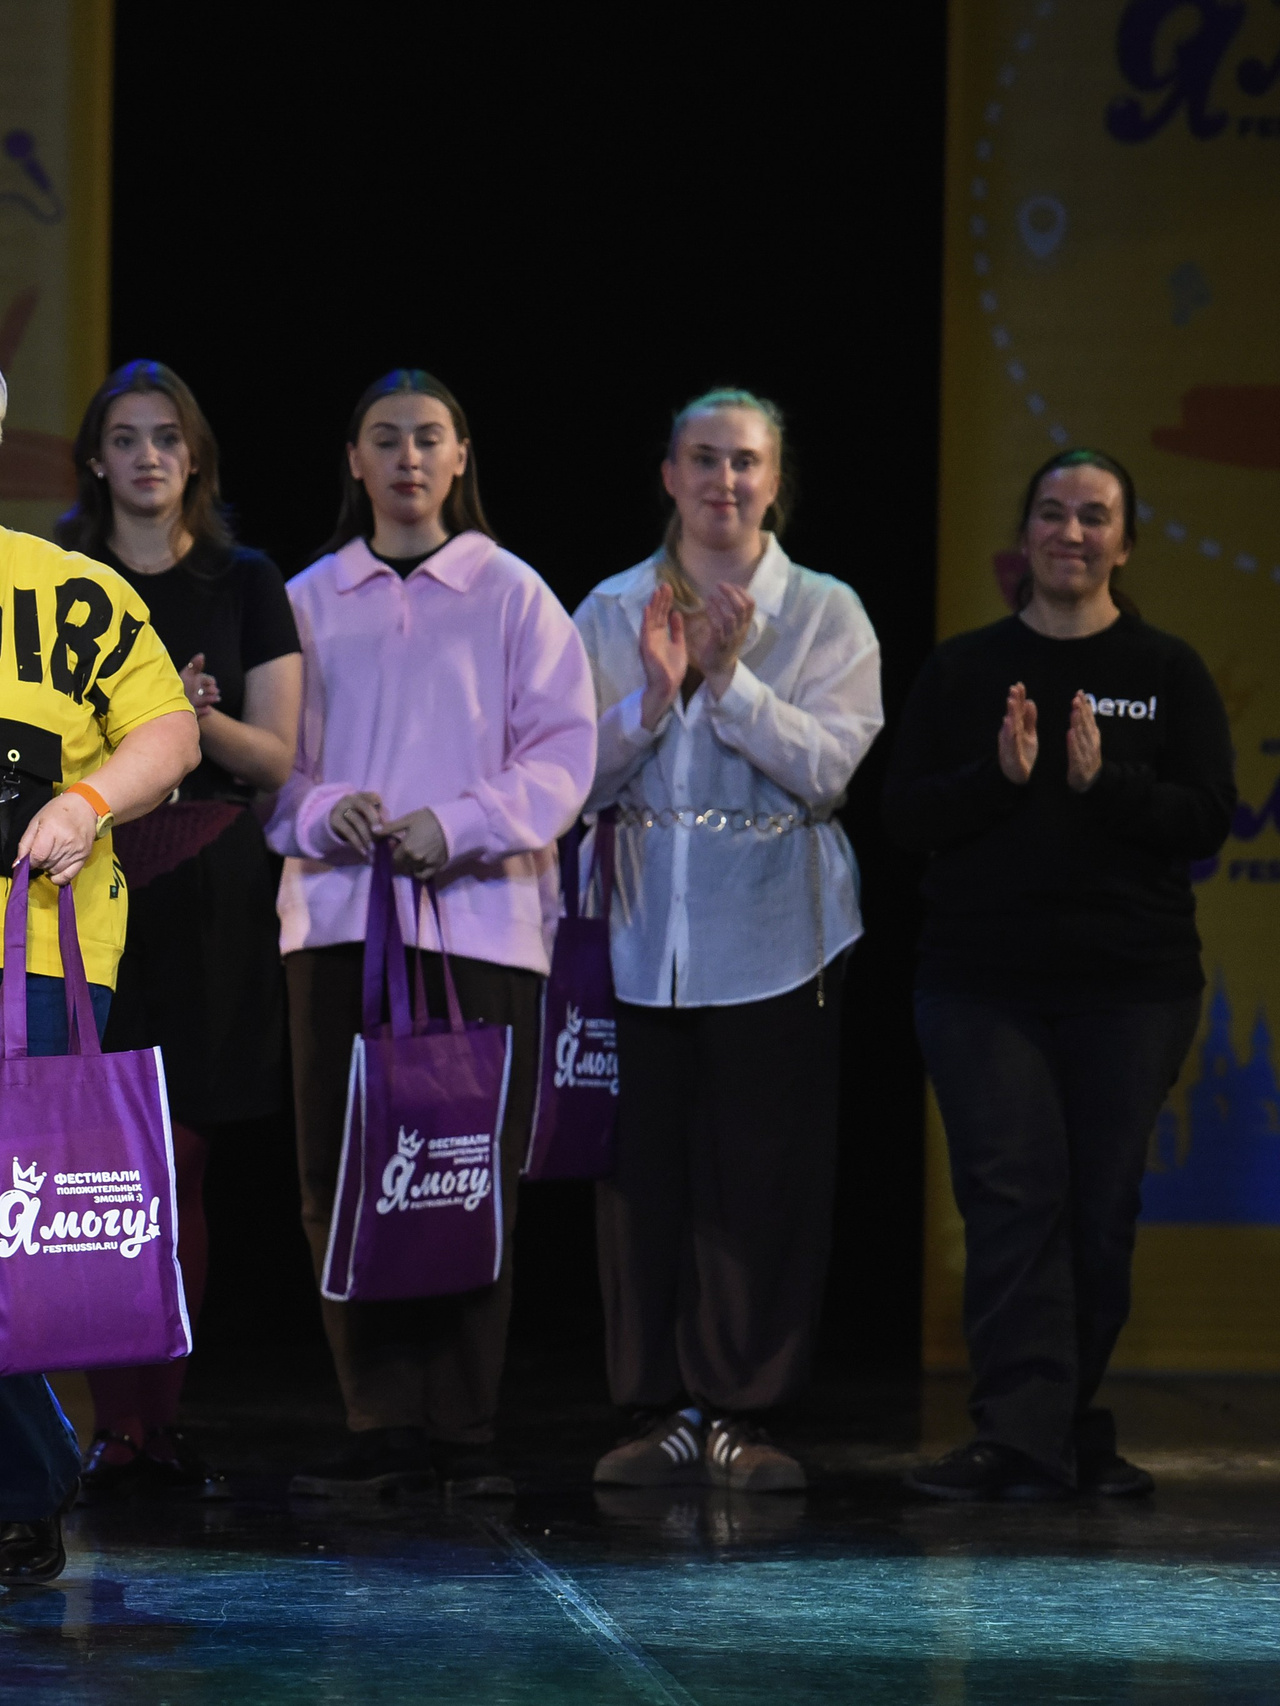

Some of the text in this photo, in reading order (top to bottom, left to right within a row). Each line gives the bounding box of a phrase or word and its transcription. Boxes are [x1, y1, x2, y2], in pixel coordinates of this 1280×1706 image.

[54, 1170, 140, 1186] ФЕСТИВАЛИ
[376, 1153, 417, 1215] Я
[56, 1184, 142, 1196] ПОЛОЖИТЕЛЬНЫХ
[93, 1193, 134, 1204] ЭМОЦИЙ
[40, 1196, 161, 1259] могу!
[42, 1241, 118, 1254] FESTRUSSIA.RU
